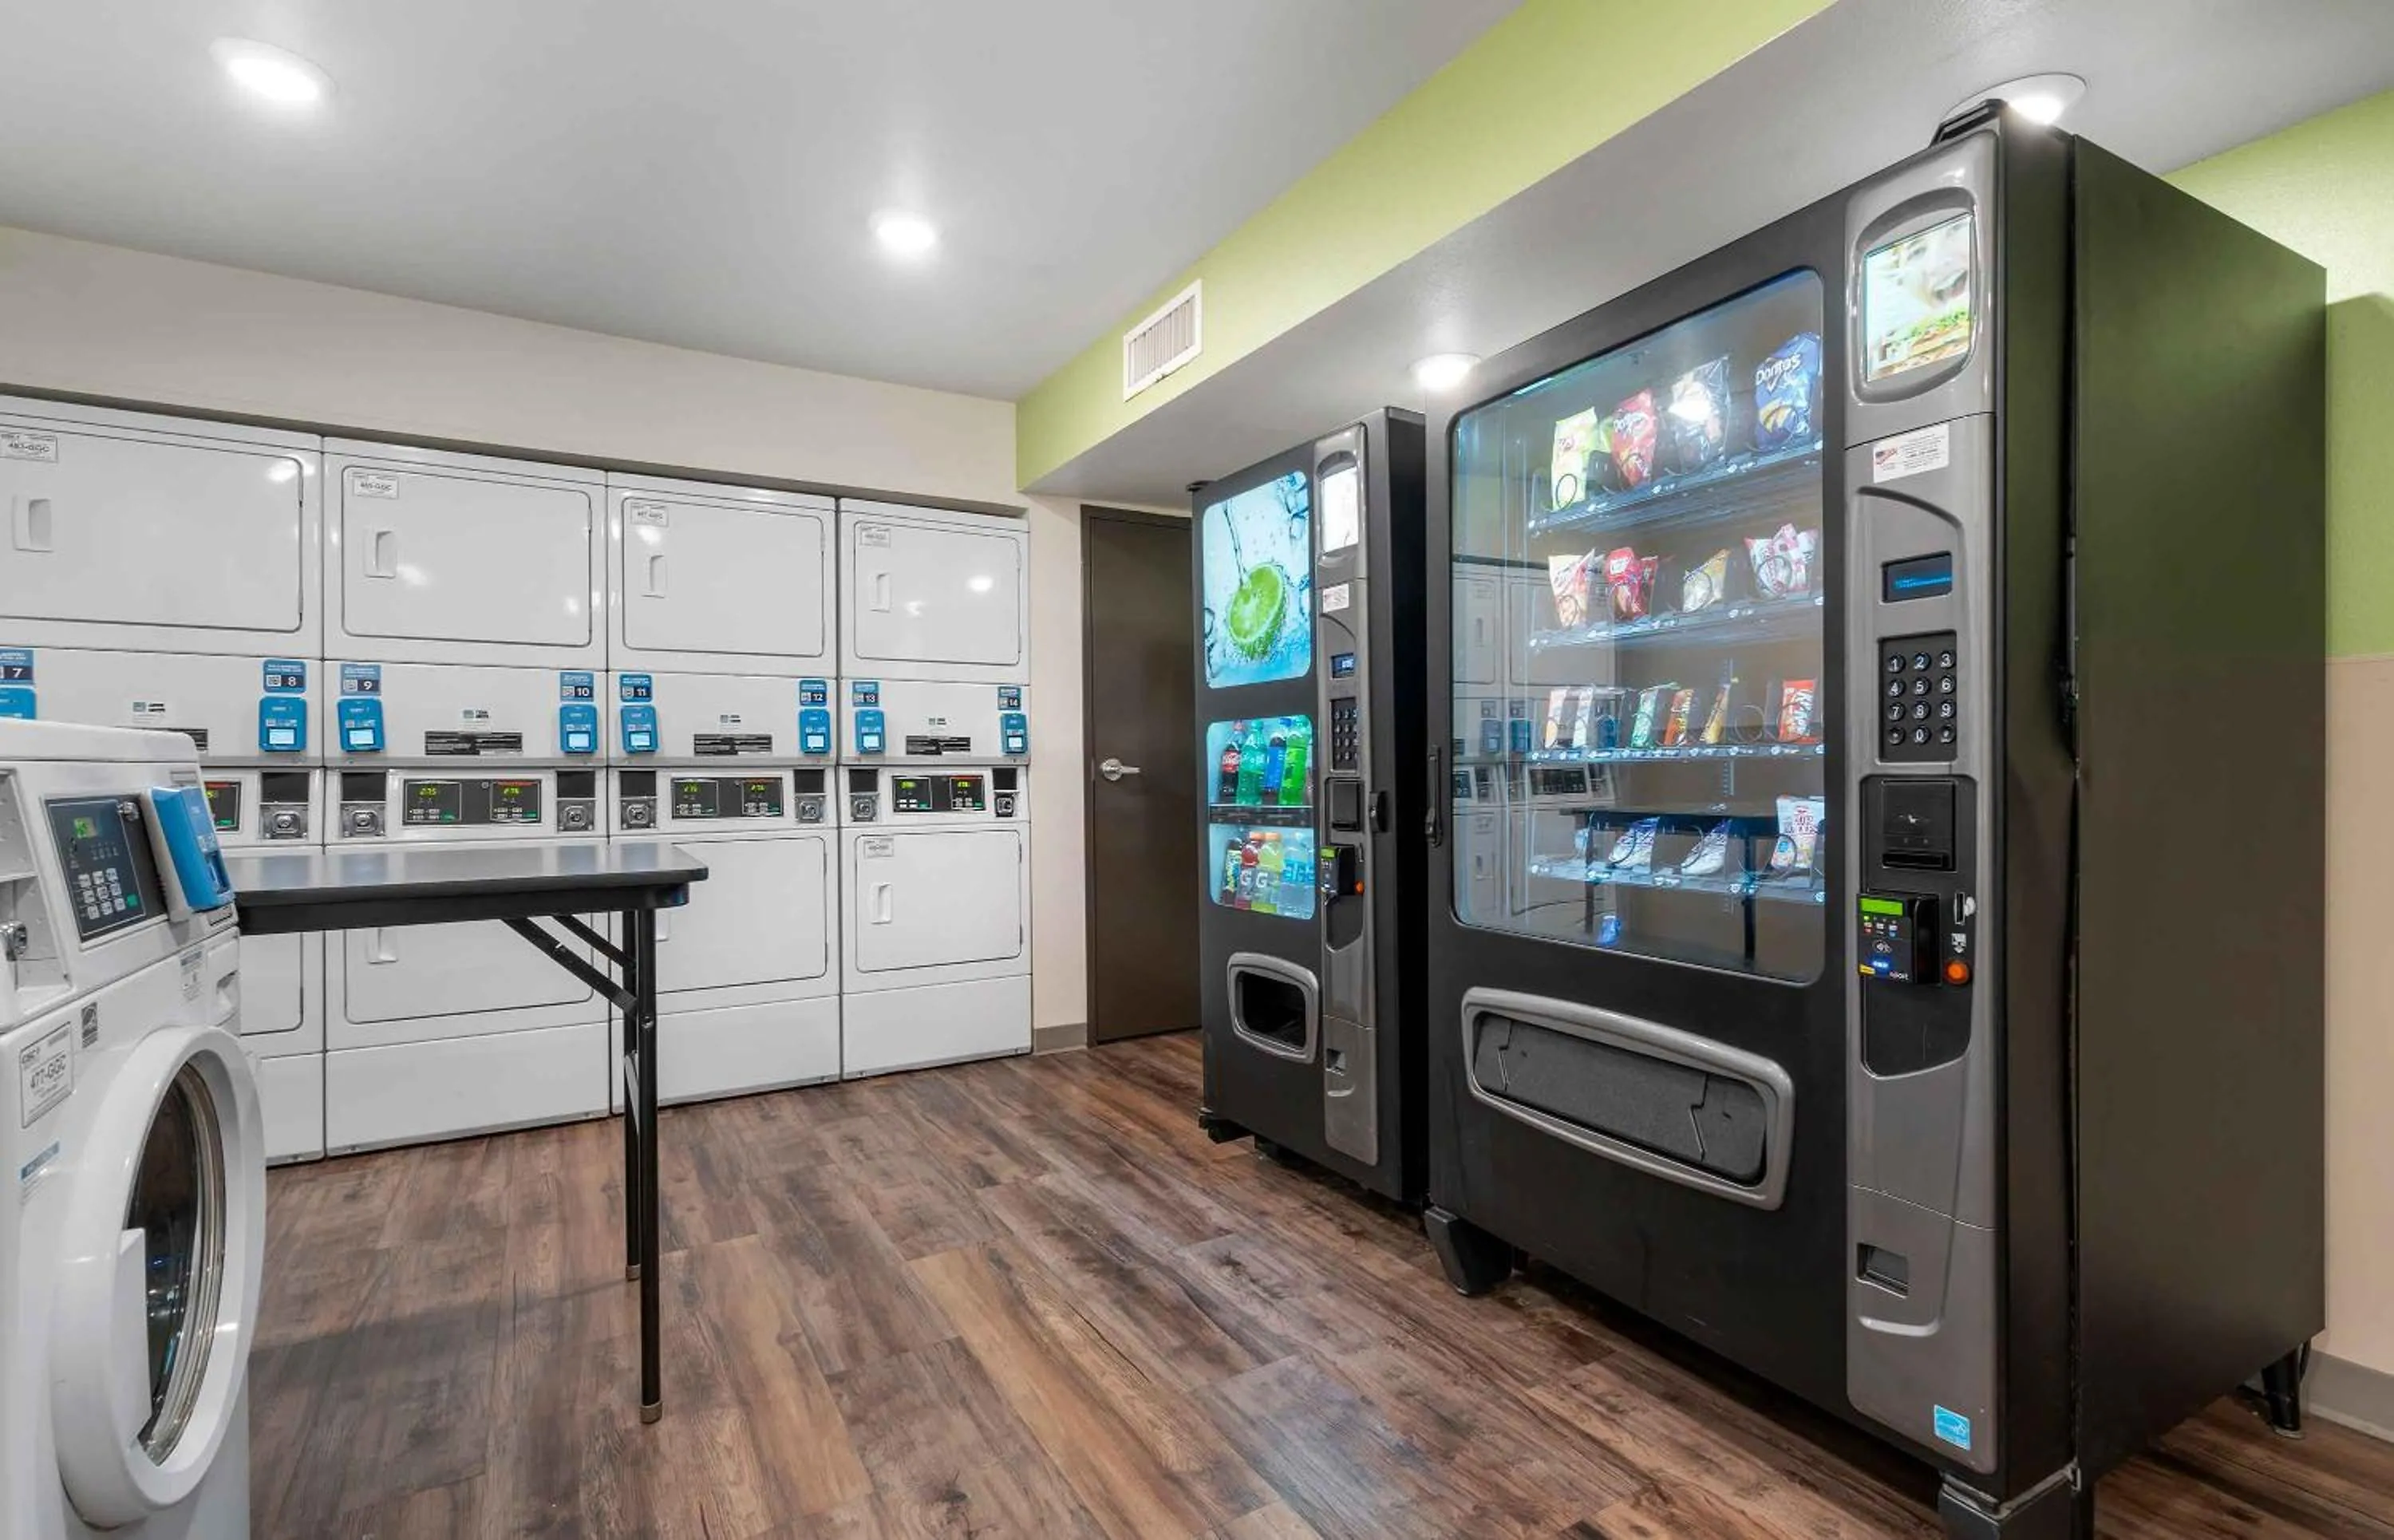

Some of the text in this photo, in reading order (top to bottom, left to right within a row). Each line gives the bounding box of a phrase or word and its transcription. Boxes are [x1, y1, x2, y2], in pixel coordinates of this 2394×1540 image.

[1755, 353, 1801, 386] Doritos
[12, 667, 24, 679] 7
[287, 676, 297, 687] 8
[363, 680, 373, 690] 9
[576, 687, 591, 697] 10
[636, 688, 646, 697] 11
[865, 693, 876, 703] 13
[1240, 868, 1253, 886] G
[1255, 871, 1269, 889] G
